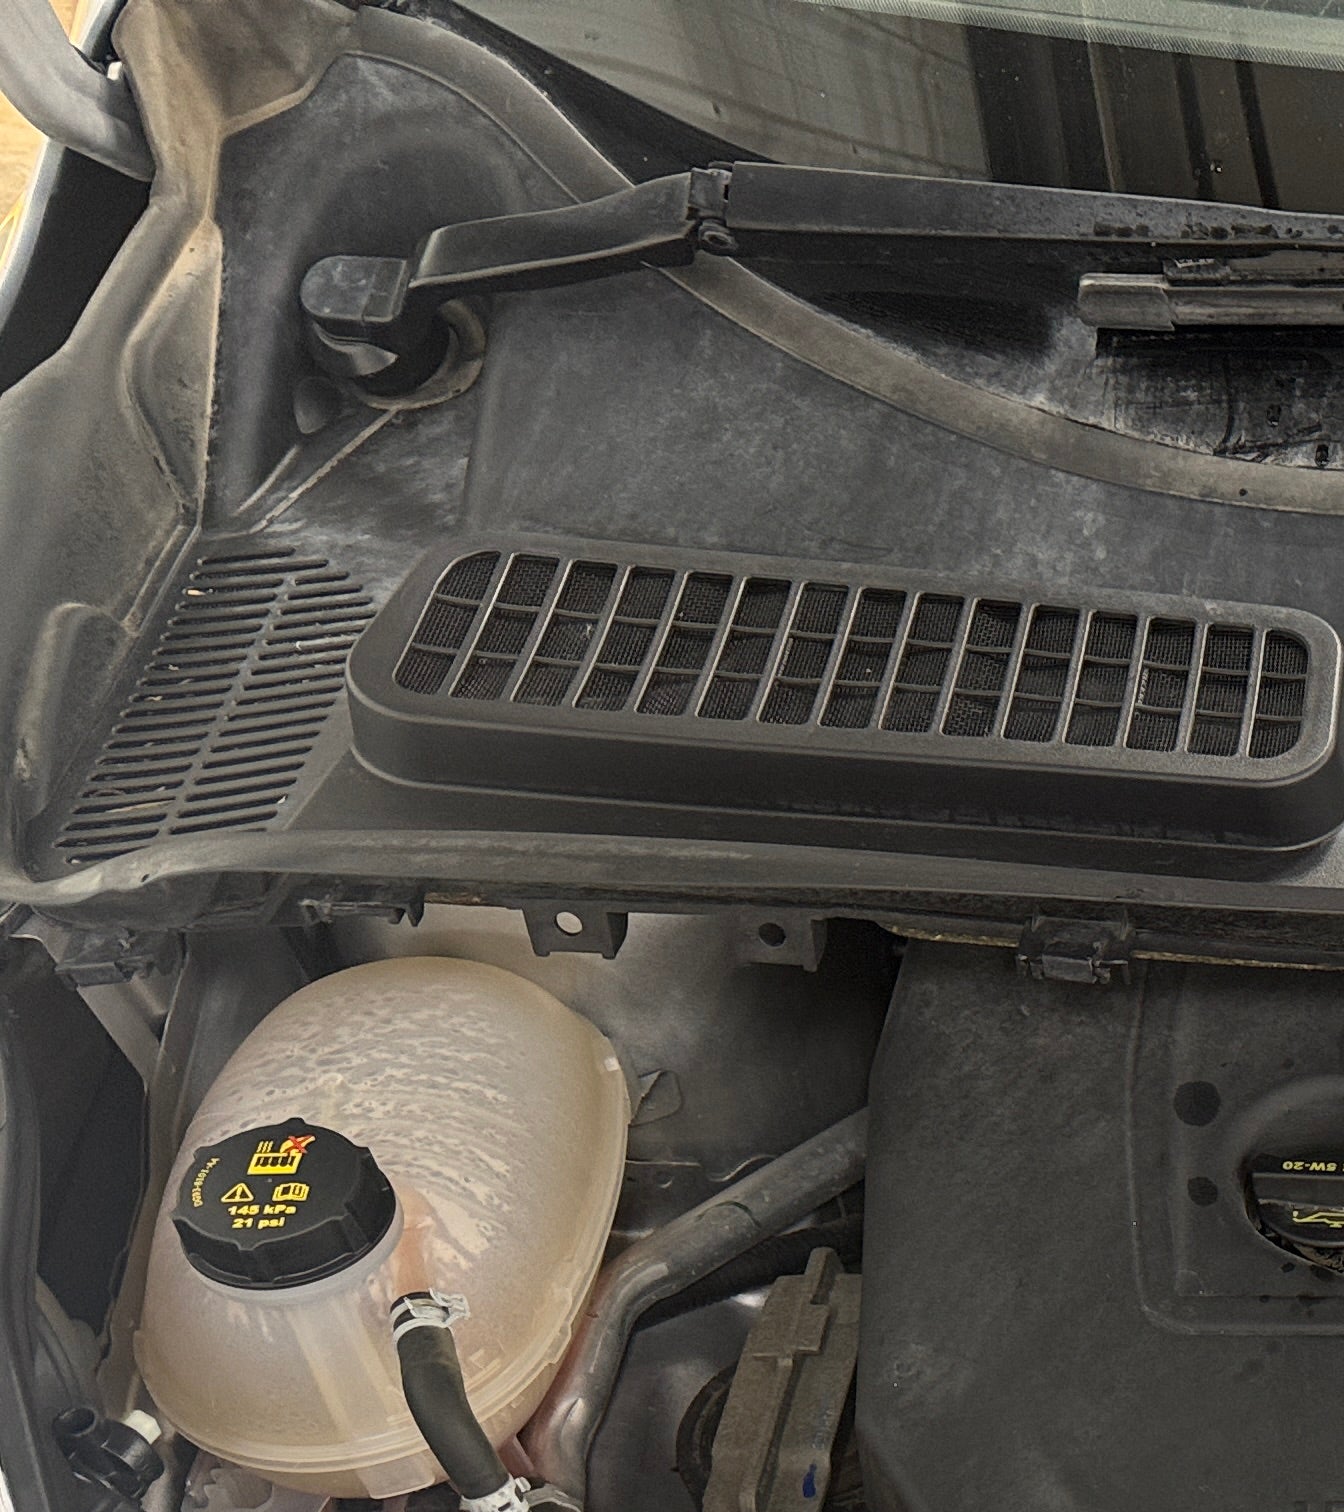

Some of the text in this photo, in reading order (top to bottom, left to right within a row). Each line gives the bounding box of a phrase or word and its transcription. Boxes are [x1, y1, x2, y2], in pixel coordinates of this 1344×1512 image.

[1282, 1161, 1338, 1173] 5W-20
[227, 1204, 297, 1215] 145 kPa
[231, 1217, 285, 1229] 21 psi
